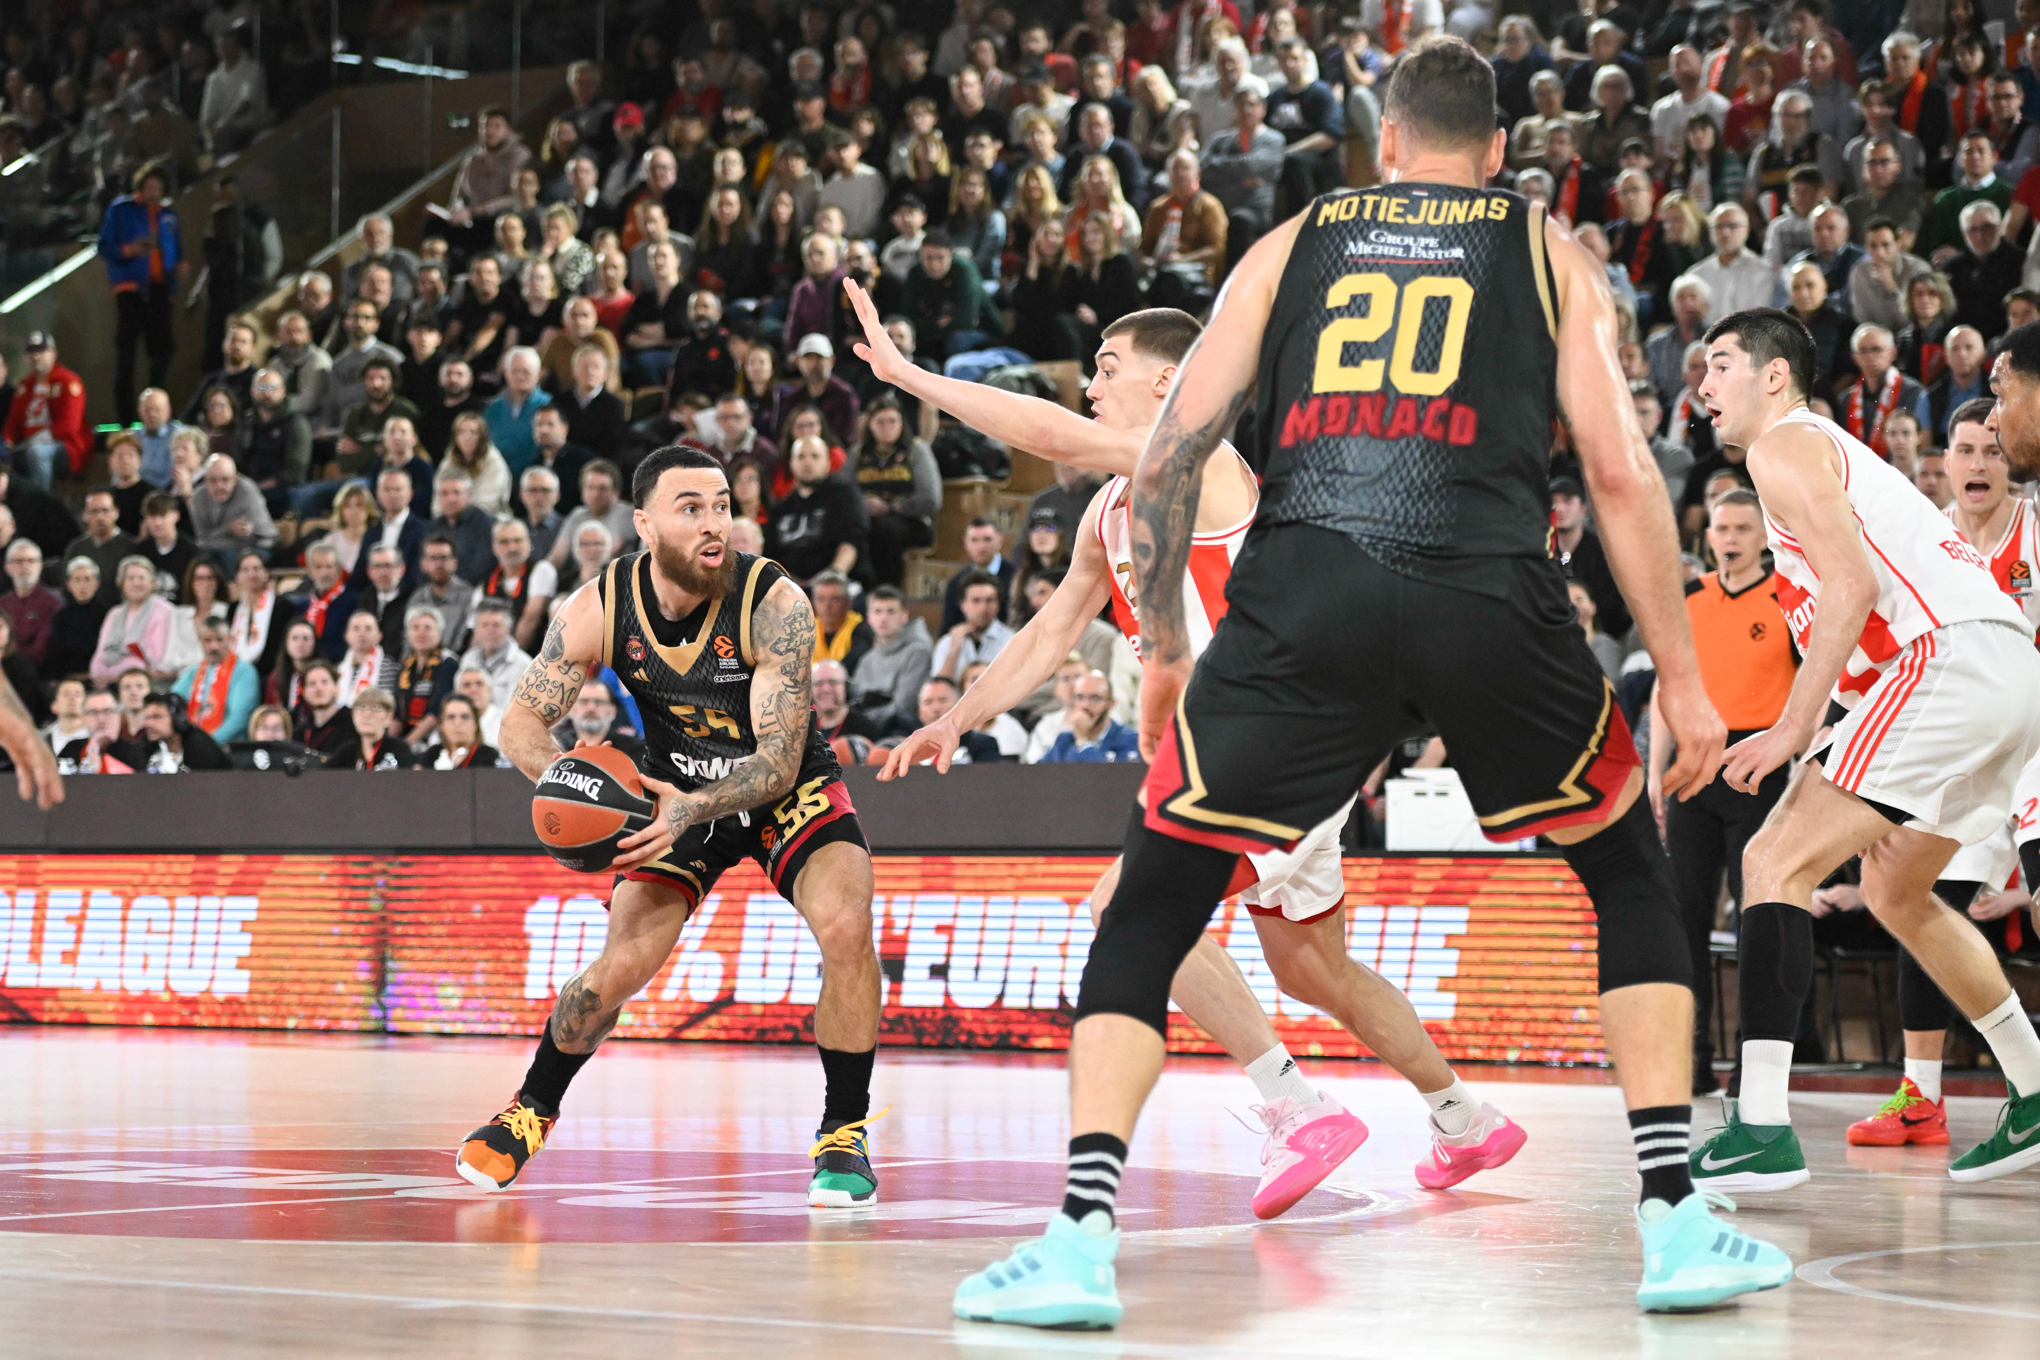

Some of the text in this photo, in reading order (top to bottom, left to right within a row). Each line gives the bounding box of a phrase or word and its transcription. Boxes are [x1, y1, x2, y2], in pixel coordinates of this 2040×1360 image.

[1317, 195, 1510, 227] MOTIEJUNAS
[1312, 272, 1475, 396] 20
[1280, 395, 1477, 447] MONACO
